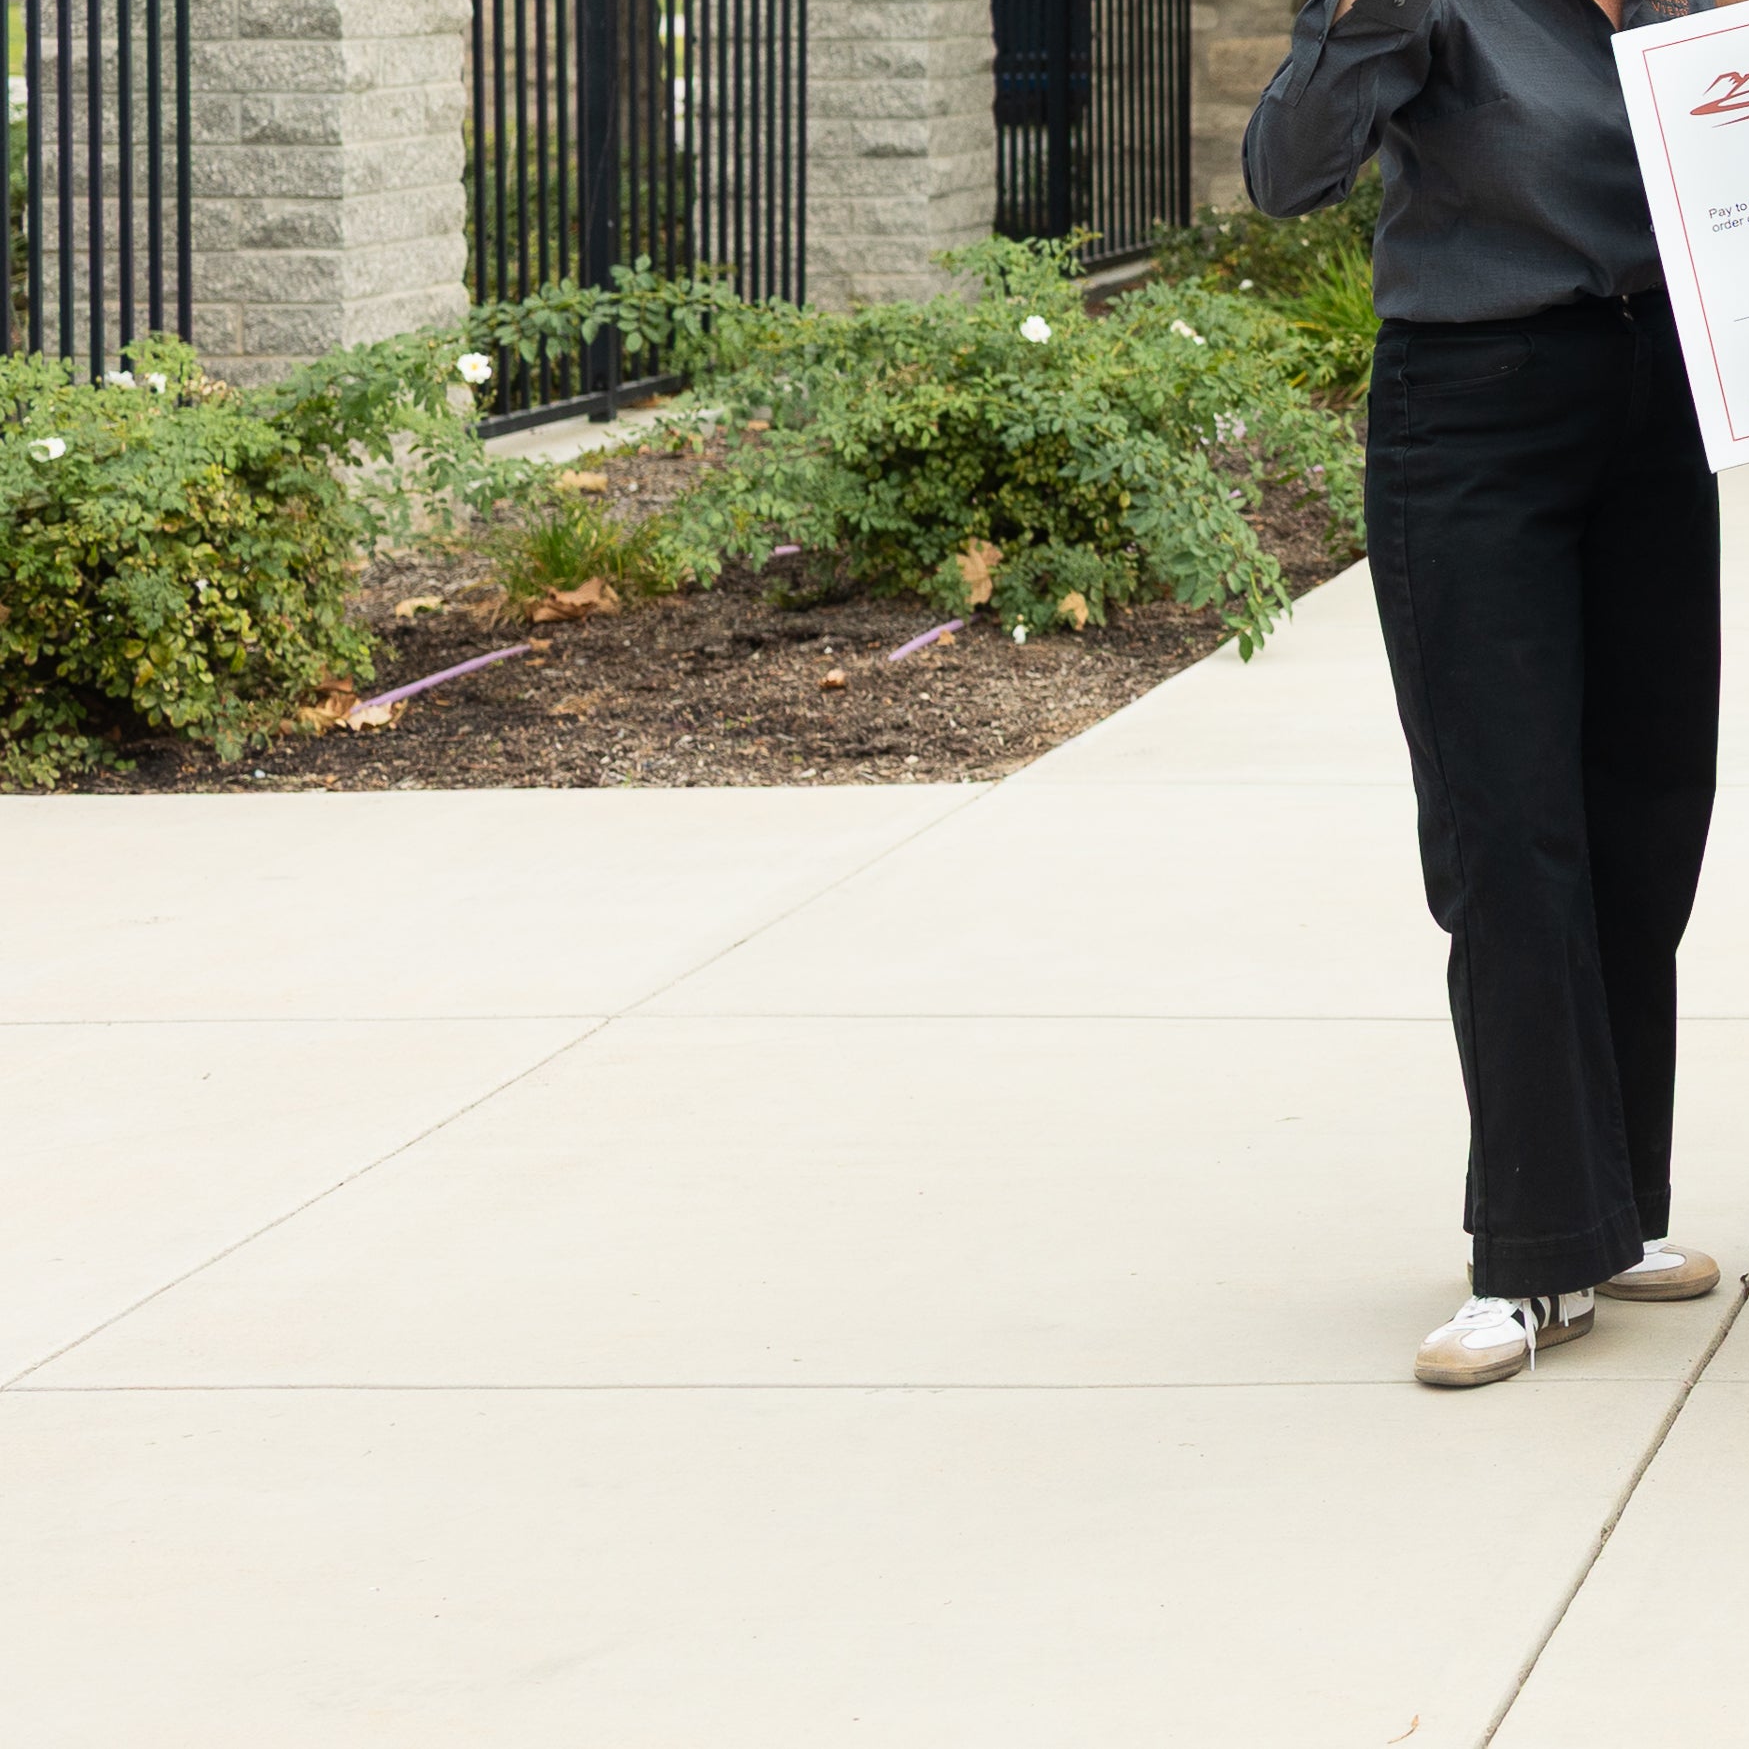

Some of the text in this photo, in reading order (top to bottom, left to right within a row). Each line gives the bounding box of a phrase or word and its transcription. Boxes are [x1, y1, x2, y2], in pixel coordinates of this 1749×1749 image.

[1708, 206, 1732, 219] Pay
[1735, 203, 1748, 213] to
[1712, 218, 1744, 233] order
